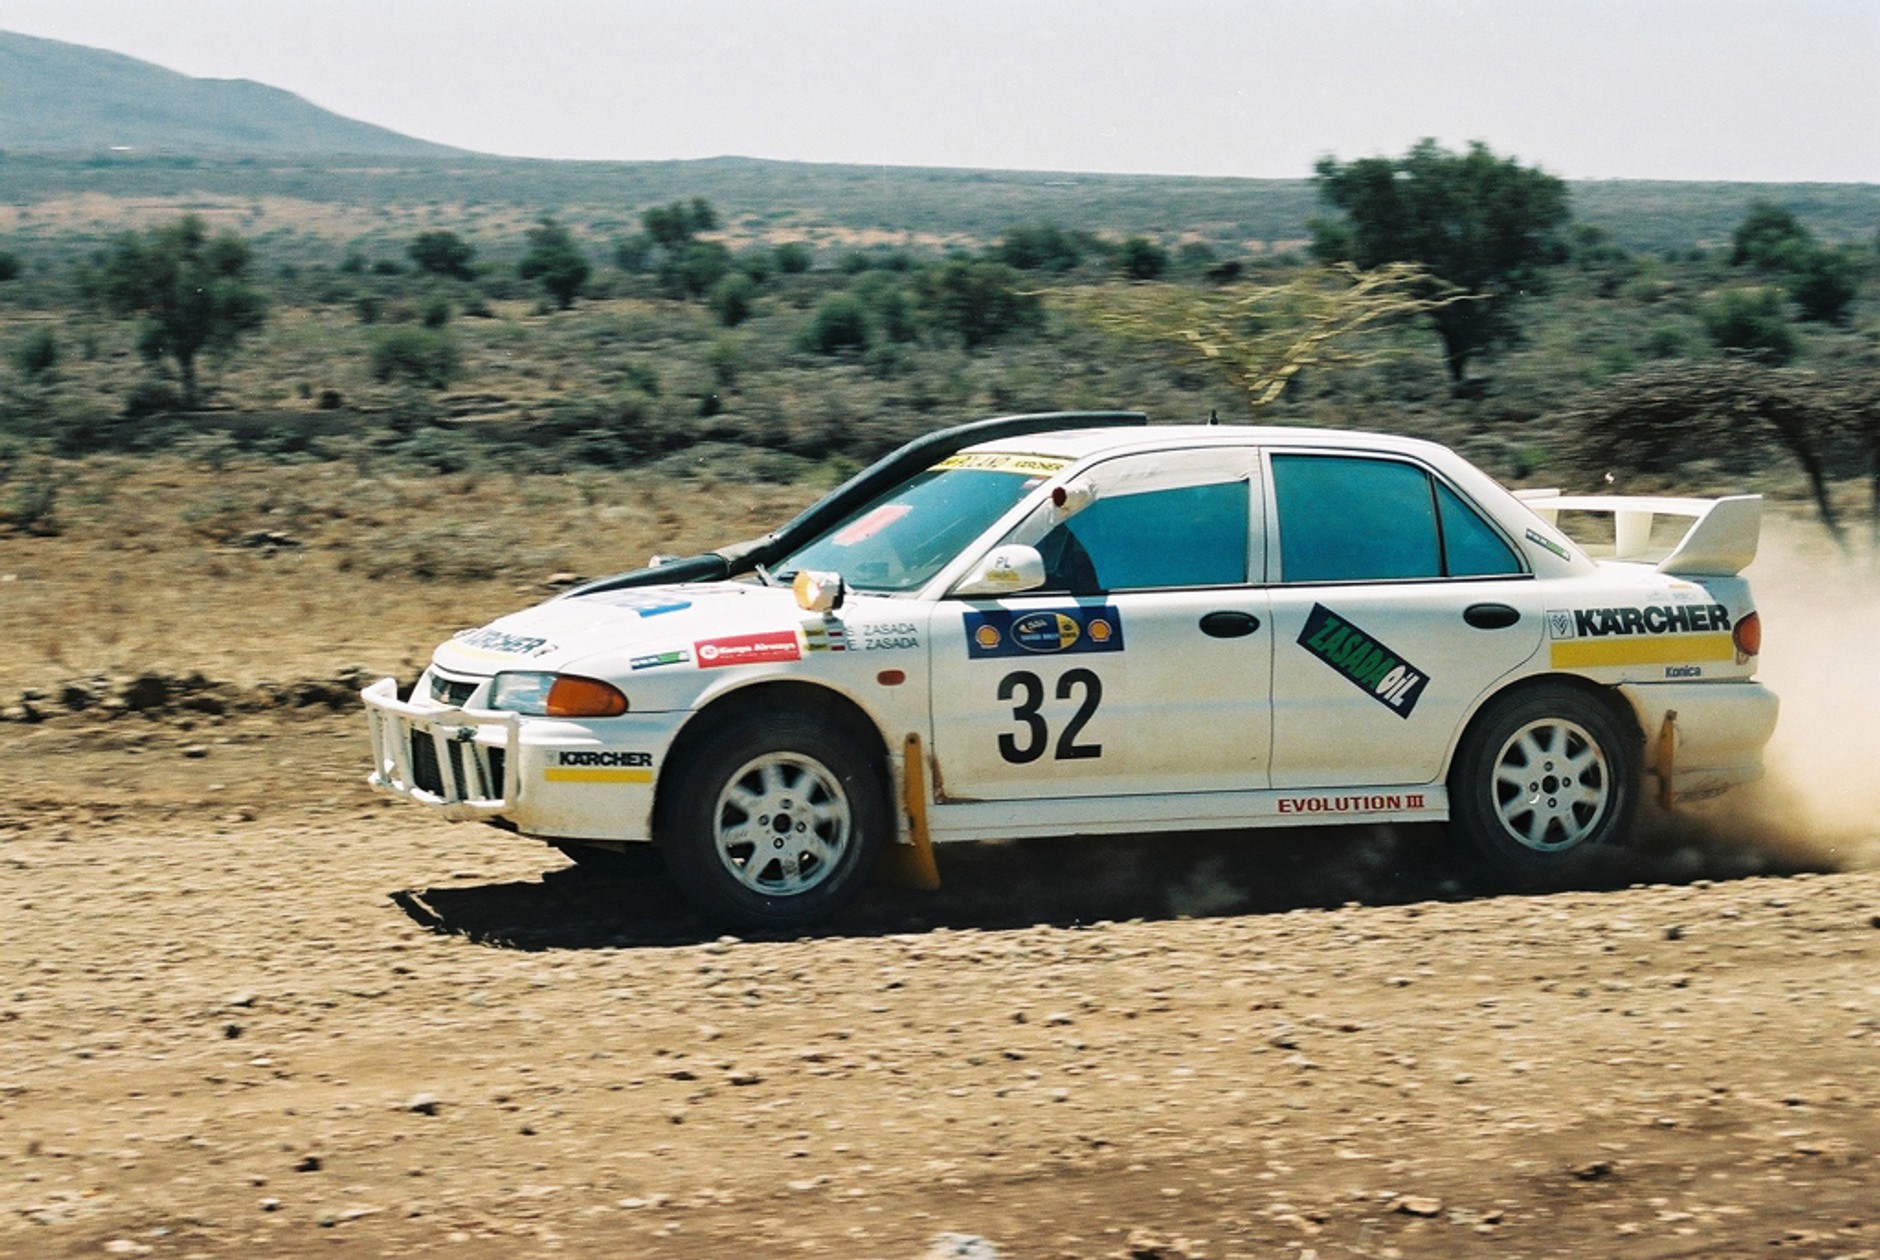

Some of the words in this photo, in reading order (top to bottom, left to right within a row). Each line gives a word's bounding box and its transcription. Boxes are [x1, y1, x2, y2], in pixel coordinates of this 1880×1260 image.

[862, 622, 918, 637] ZASADA
[1573, 603, 1732, 637] KÄRCHER
[865, 637, 920, 650] ZASADA
[1306, 616, 1397, 690] ZASADA
[1664, 665, 1702, 678] Konica
[997, 667, 1103, 765] 32
[1277, 795, 1401, 814] EVOLUTION
[1405, 794, 1425, 808] III
